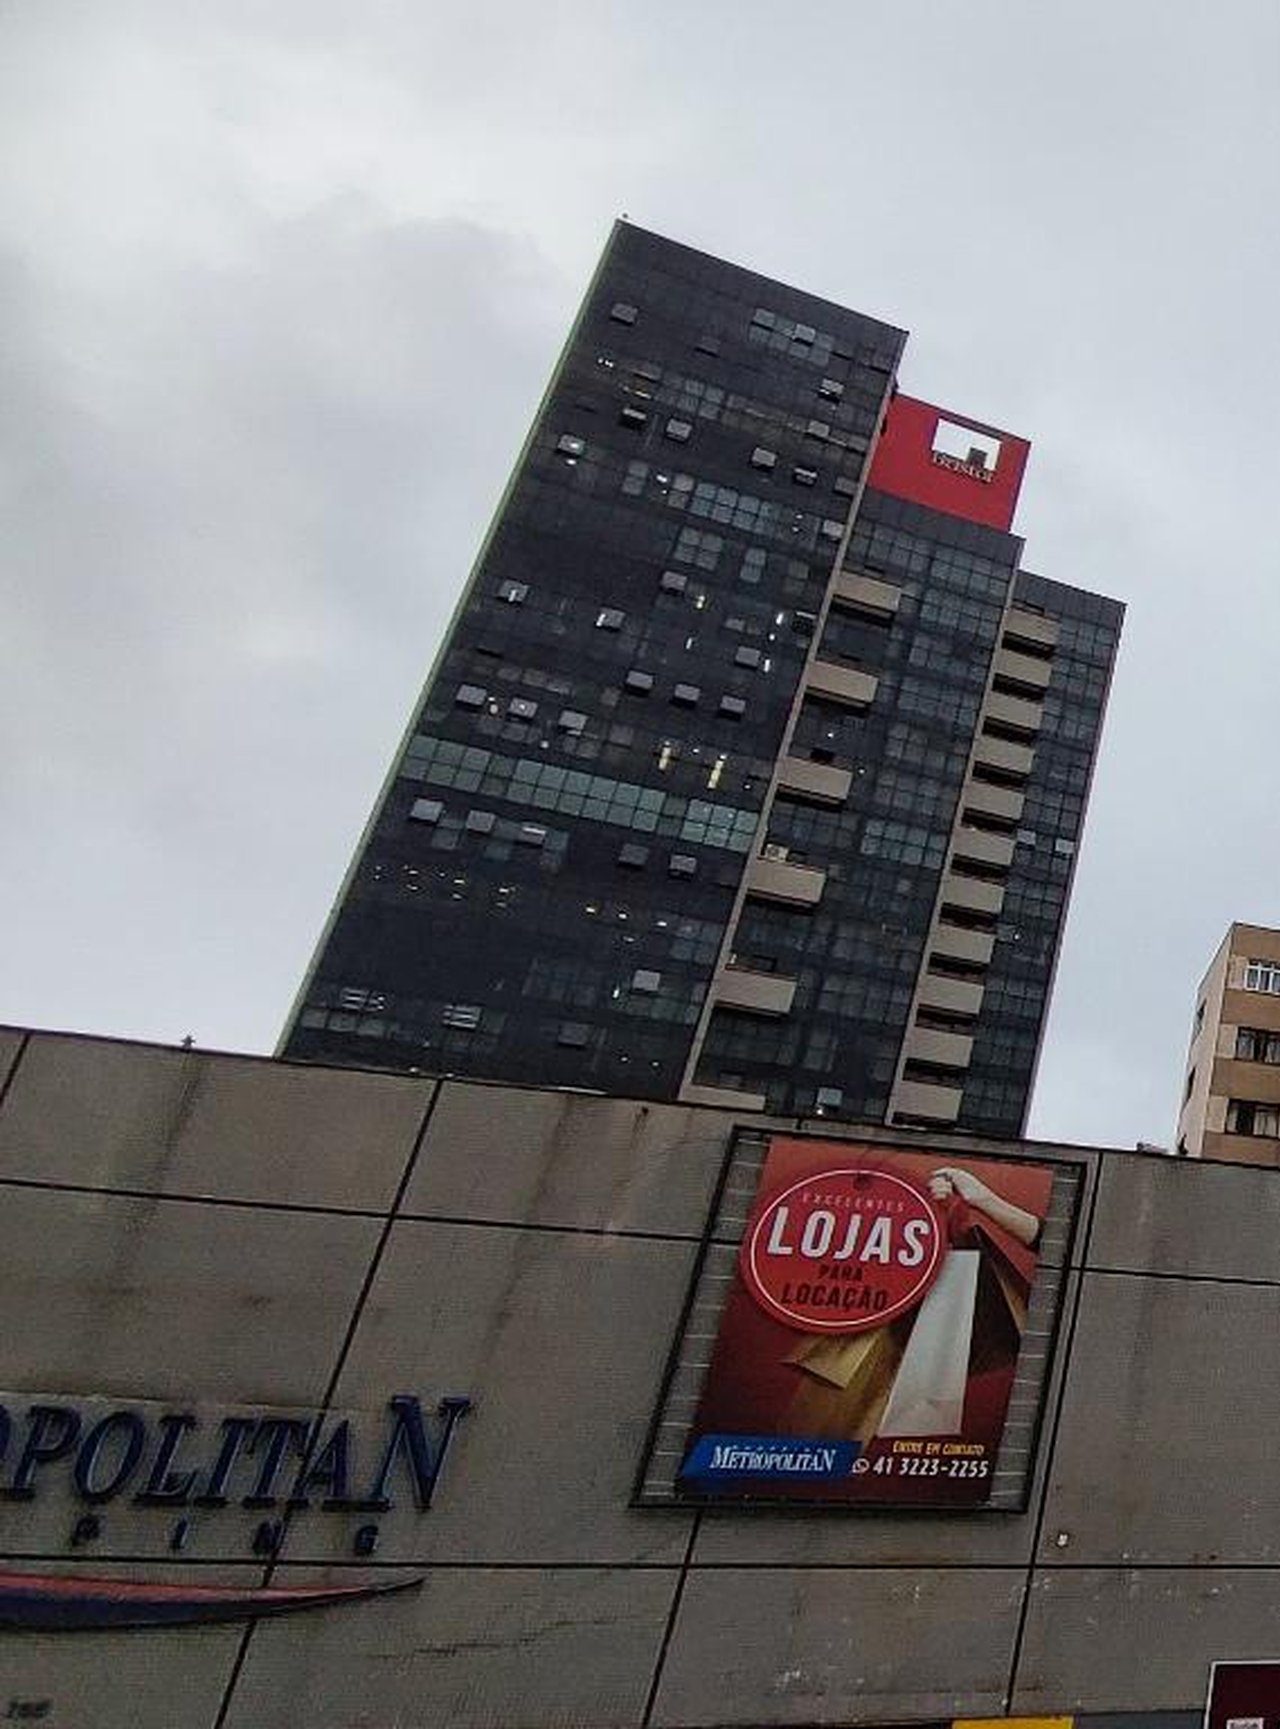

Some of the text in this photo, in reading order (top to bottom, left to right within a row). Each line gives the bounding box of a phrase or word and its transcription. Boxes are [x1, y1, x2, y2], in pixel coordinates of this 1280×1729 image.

[767, 1206, 931, 1267] LOJAS
[818, 1265, 863, 1281] PARA
[782, 1283, 888, 1311] LOCAÇÃO
[0, 1394, 471, 1513] POLITAN
[873, 1457, 989, 1478] 41 3223-2255
